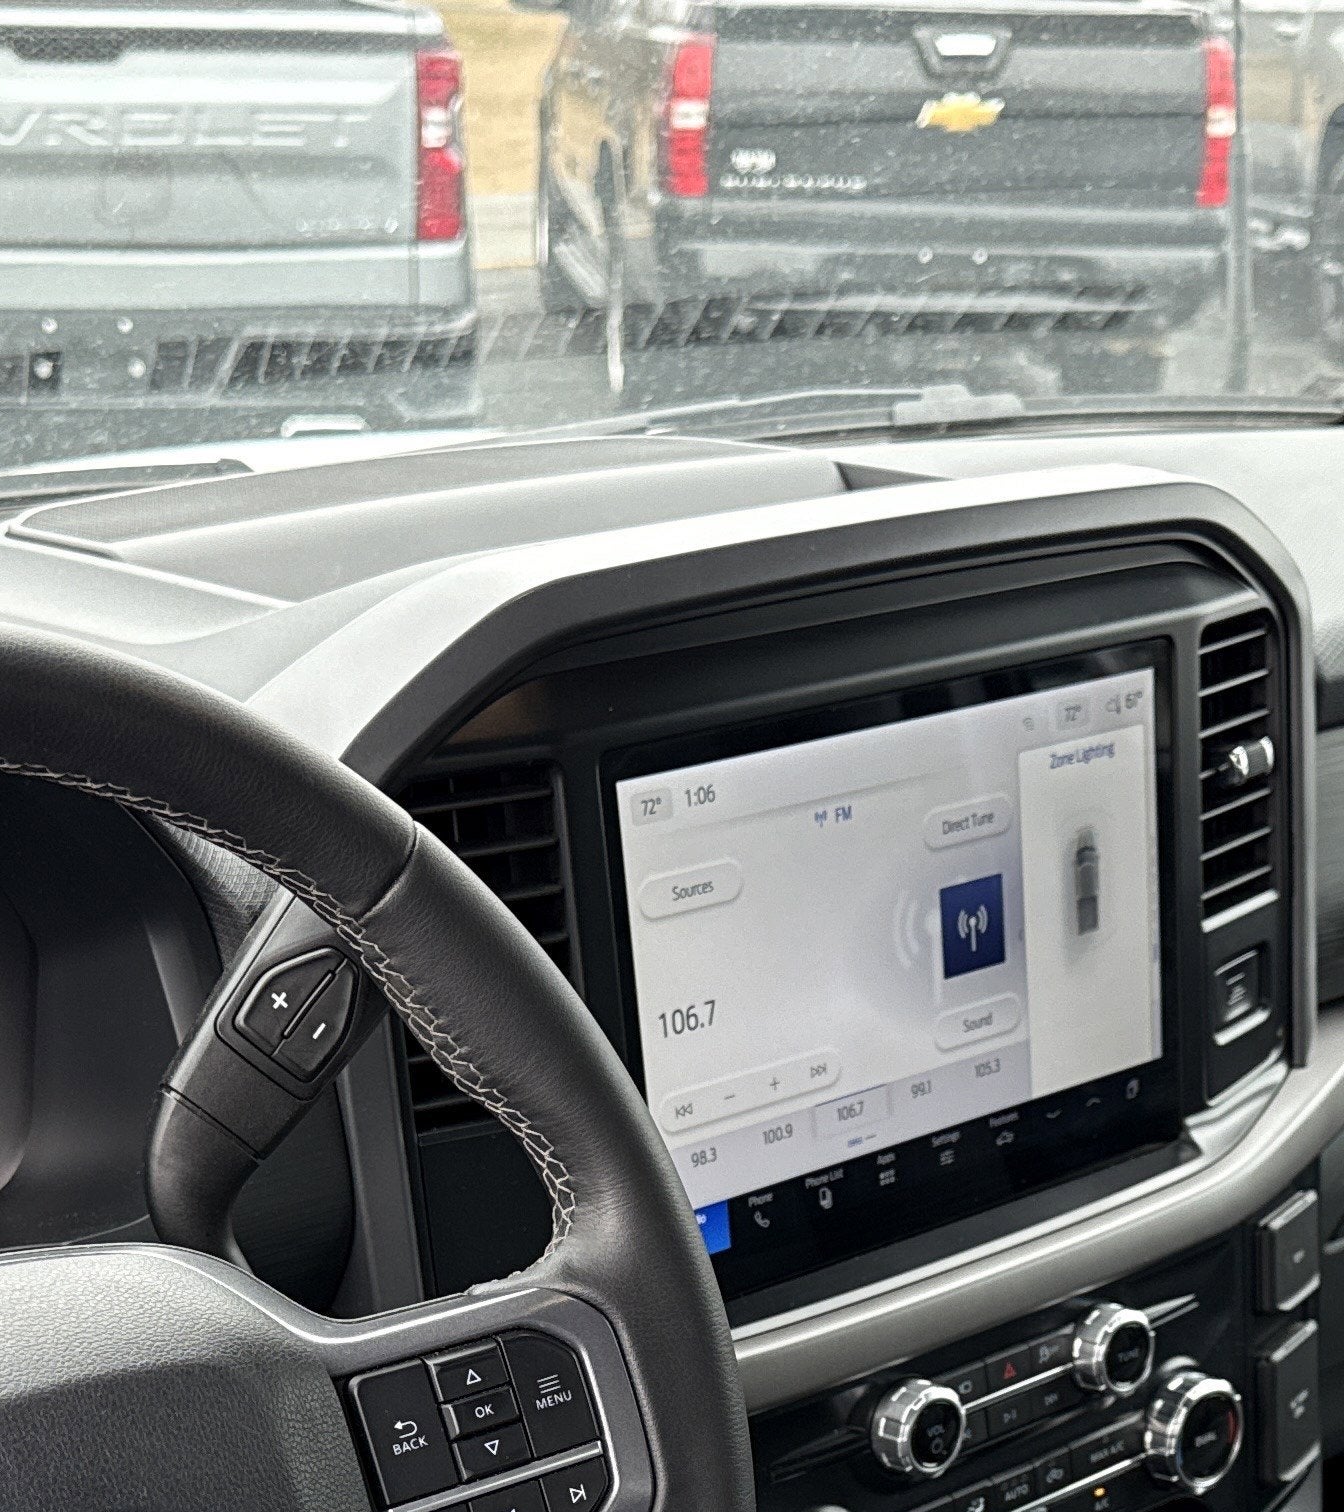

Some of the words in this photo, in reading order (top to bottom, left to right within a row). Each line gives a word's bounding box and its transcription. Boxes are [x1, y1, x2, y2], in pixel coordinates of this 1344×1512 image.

[684, 784, 716, 808] 1:06
[835, 805, 853, 824] FM
[942, 816, 970, 835] Direct
[971, 812, 995, 828] Tune
[672, 880, 715, 901] Sources
[658, 999, 717, 1039] 106.7
[962, 1012, 994, 1033] Sound
[836, 1101, 865, 1123] 106.7
[762, 1123, 794, 1146] 100.9
[691, 1147, 718, 1168] 98.3
[474, 1403, 495, 1419] OK
[535, 1390, 573, 1411] MENU
[927, 1423, 946, 1438] VOL
[392, 1435, 429, 1456] BACK
[1004, 1483, 1030, 1502] AUTO
